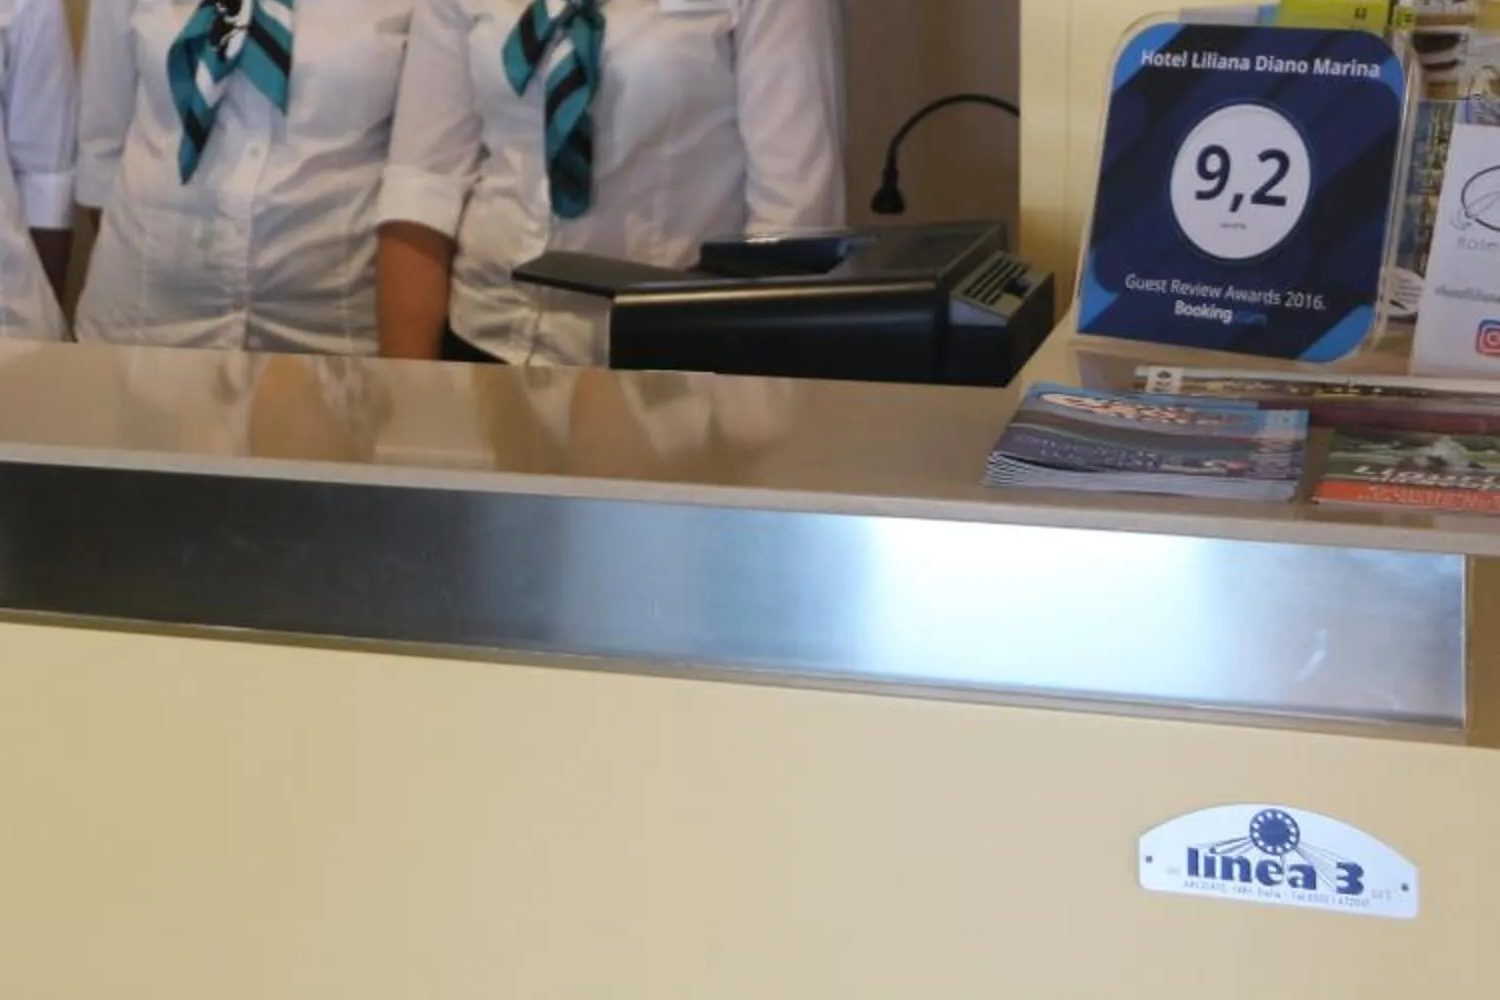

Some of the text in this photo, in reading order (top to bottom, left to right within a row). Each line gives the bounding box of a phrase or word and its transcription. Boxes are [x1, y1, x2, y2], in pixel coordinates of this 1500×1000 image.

[1141, 50, 1381, 78] Hotel Liliana Diano Marina
[1195, 144, 1290, 213] 9,2
[1125, 274, 1326, 310] Guest Review Awards 2016.
[1187, 846, 1364, 895] linea 3
